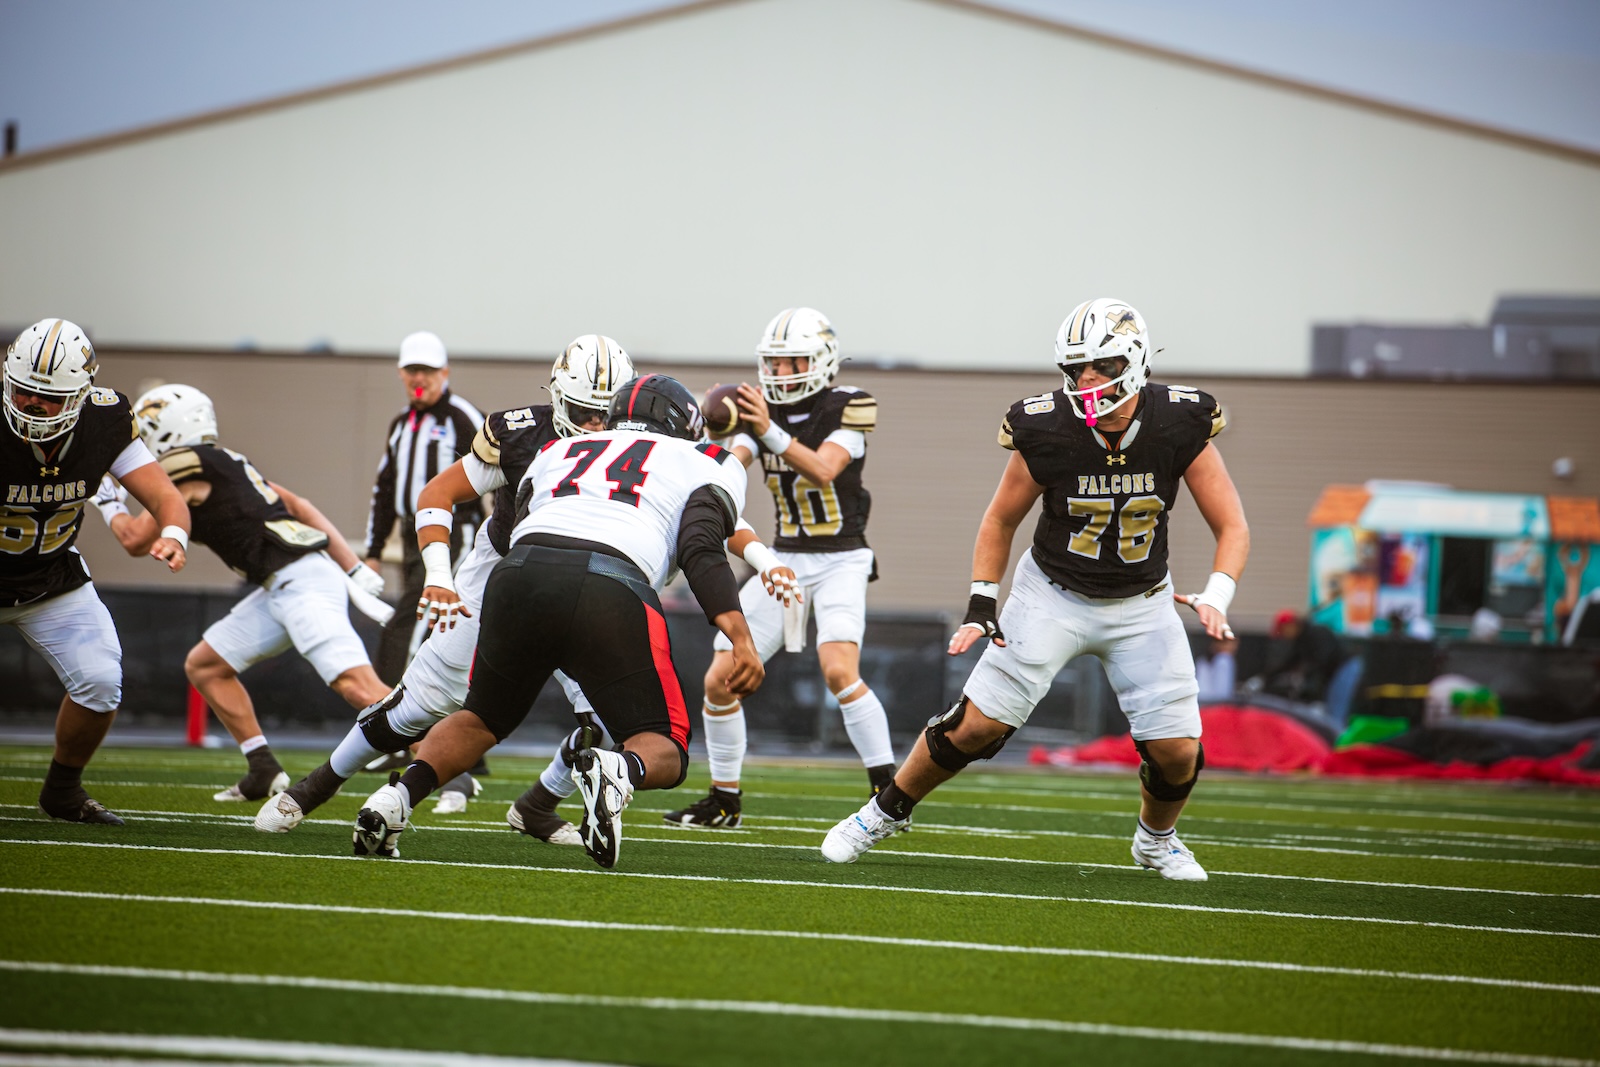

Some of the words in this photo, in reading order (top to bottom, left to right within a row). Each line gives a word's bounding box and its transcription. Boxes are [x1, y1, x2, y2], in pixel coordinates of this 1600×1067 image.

[503, 407, 537, 431] 51
[6, 480, 87, 503] FALCONS
[551, 439, 657, 509] 74
[1077, 472, 1155, 495] FALCONS
[0, 498, 88, 555] 62
[766, 474, 843, 537] 10
[1066, 494, 1166, 564] 78
